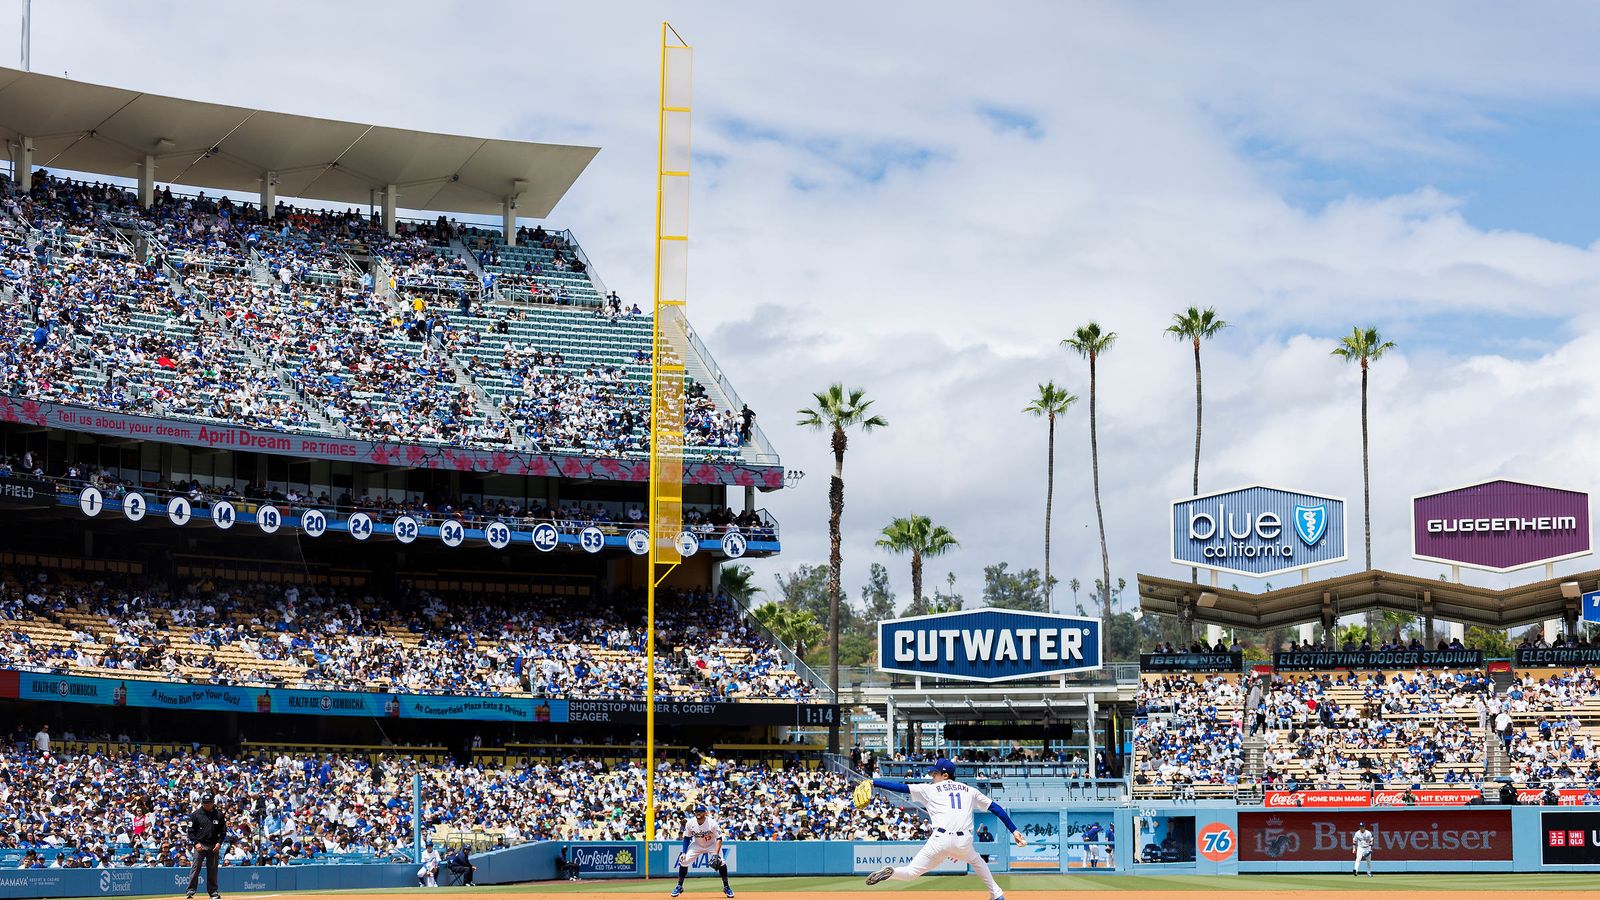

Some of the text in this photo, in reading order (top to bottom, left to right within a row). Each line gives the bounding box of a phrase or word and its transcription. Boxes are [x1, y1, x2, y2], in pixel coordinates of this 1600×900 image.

[57, 409, 76, 423] Tell
[80, 415, 92, 426] us
[95, 417, 125, 431] about
[128, 423, 154, 434] your
[156, 424, 193, 439] dream.
[198, 426, 235, 446] April
[239, 430, 291, 450] Dream
[5, 484, 34, 499] FIELD
[90, 494, 95, 510] 1
[131, 498, 139, 515] 2
[174, 503, 183, 519] 4
[217, 507, 231, 523] 14
[263, 511, 276, 527] 19
[306, 515, 323, 531] 20
[352, 518, 370, 534] 24
[397, 521, 416, 538] 32
[1189, 504, 1282, 539] blue
[1427, 516, 1576, 533] GUGGENHEIM
[443, 525, 462, 541] 34
[490, 528, 508, 543] 39
[535, 529, 555, 545] 42
[583, 532, 601, 547] 53
[1203, 542, 1293, 558] california
[894, 628, 1084, 662] CUTWATER
[1200, 655, 1233, 665] NECA
[1279, 651, 1478, 665] ELECTRIFYING DODGER STADIUM
[151, 689, 158, 699] A
[160, 692, 178, 705] Home
[179, 695, 192, 705] Run
[205, 689, 222, 699] Your
[414, 703, 424, 713] At
[424, 704, 463, 715] Centerfield
[464, 702, 481, 711] Plaza
[482, 701, 498, 710] Eats
[504, 704, 527, 718] Drinks
[569, 702, 627, 713] SHORTSTOP
[672, 705, 681, 715] 5,
[683, 705, 716, 714] COREY
[806, 708, 834, 723] 1:14
[569, 712, 612, 722] SEAGER.
[943, 784, 969, 792] SASAKI
[949, 792, 962, 809] 11
[1307, 795, 1328, 803] HOME
[1329, 795, 1343, 803] RUN
[1344, 795, 1367, 803] MAGIC
[1139, 808, 1157, 817] 360
[648, 843, 663, 851] 330
[1203, 830, 1232, 852] 76
[574, 848, 614, 867] Surfside
[856, 856, 882, 864] BANK
[884, 856, 897, 864] OF
[112, 870, 133, 884] Security
[112, 881, 131, 892] Benefit
[244, 881, 266, 890] Budweiser
